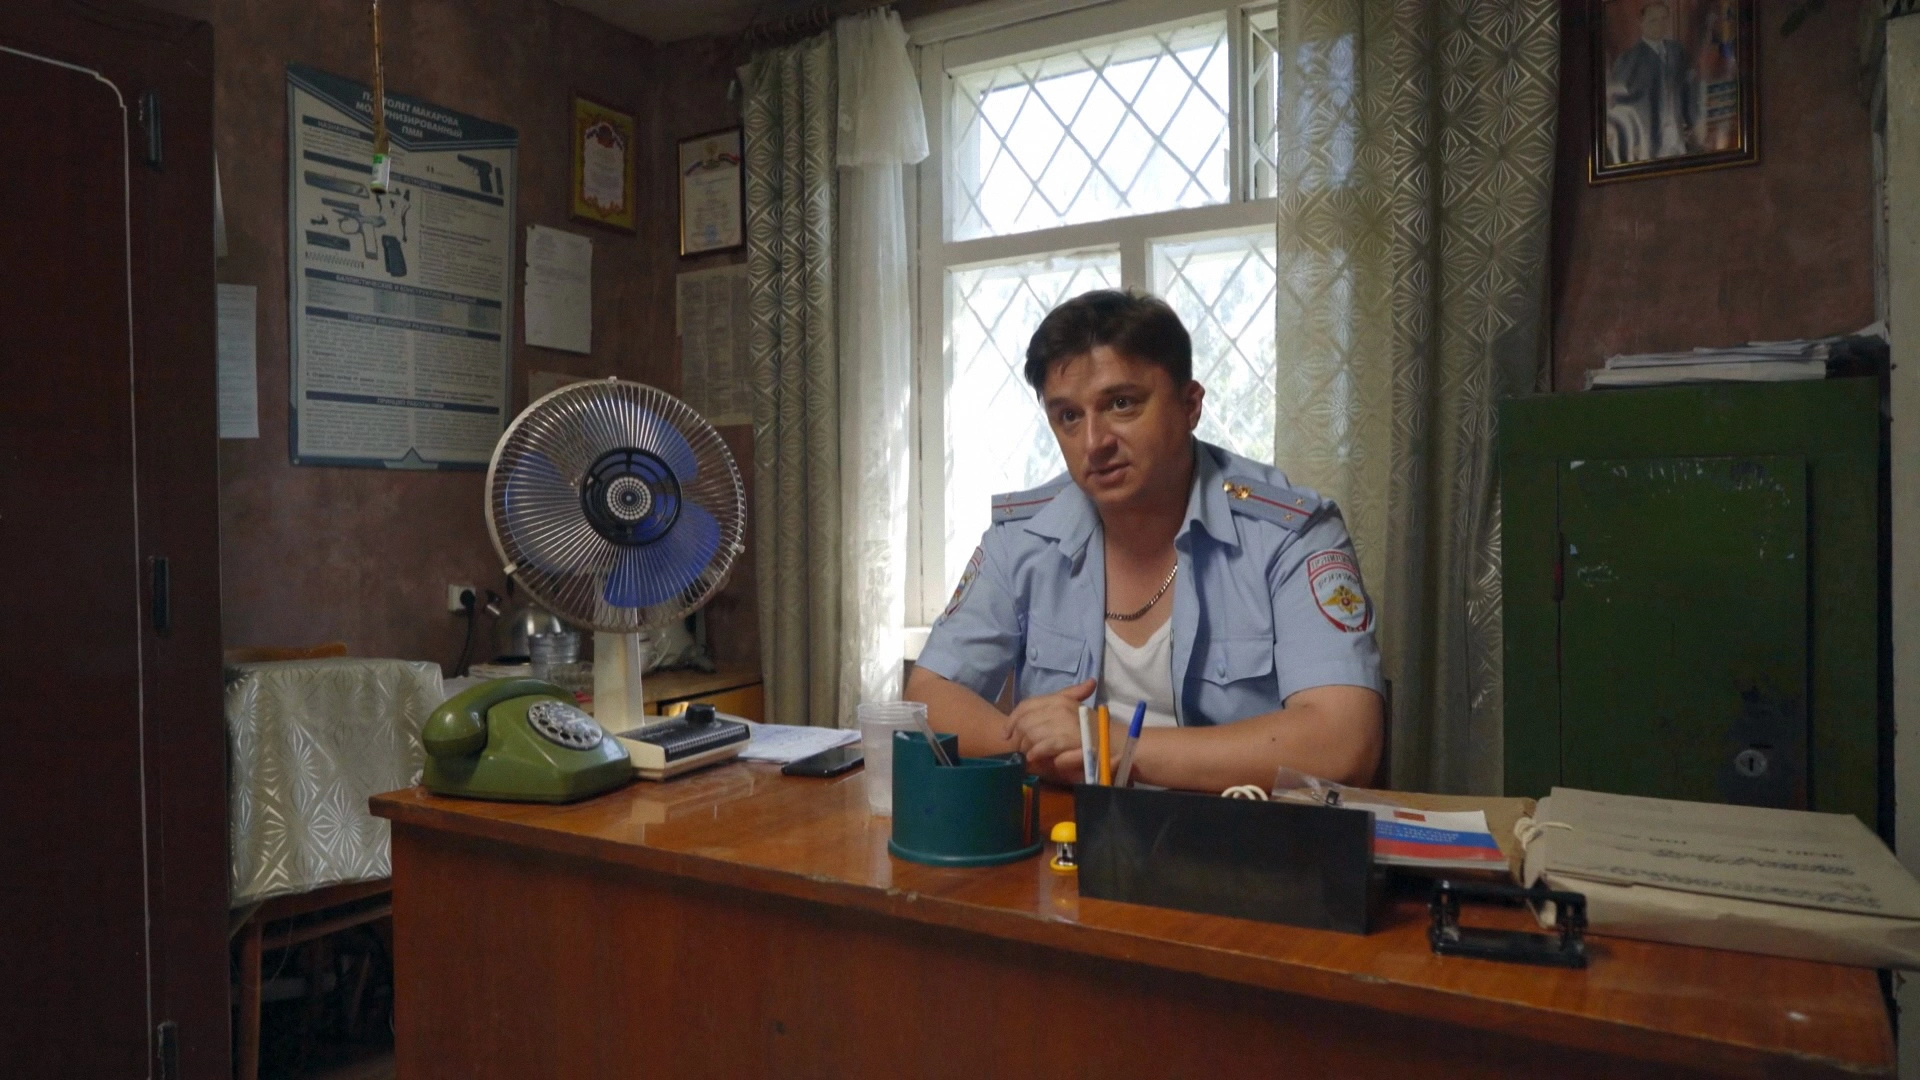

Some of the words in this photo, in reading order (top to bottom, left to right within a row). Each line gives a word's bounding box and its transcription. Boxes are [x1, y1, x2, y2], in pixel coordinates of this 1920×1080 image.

[355, 101, 463, 138] МОРНИЗИРОВАННЫЙ
[362, 91, 410, 112] ПТОЛЕТ
[412, 106, 459, 127] МАКАРОВА
[402, 126, 423, 138] ПММ
